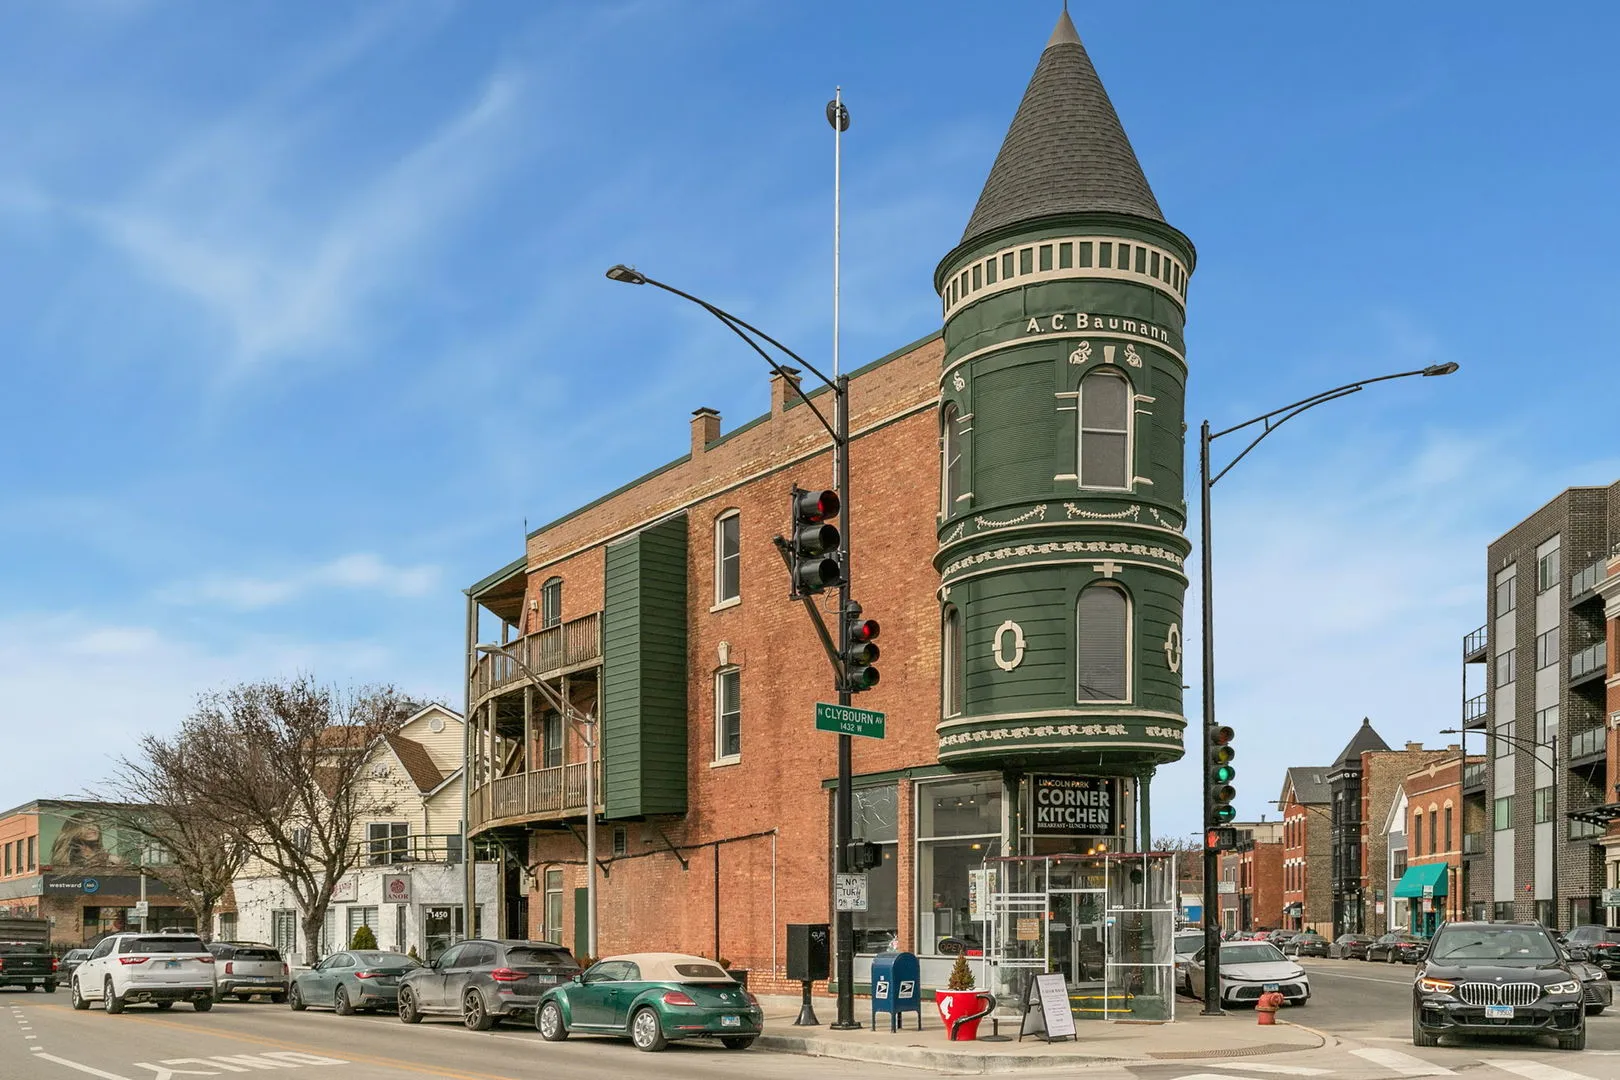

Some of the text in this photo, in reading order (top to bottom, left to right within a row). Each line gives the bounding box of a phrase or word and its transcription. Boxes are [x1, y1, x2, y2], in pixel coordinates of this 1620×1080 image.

[1026, 317, 1045, 333] A.
[1051, 314, 1068, 330] C.
[825, 707, 873, 724] CLYBOURN
[840, 722, 855, 732] 1432
[1038, 789, 1110, 806] CORNER
[1037, 807, 1109, 823] KITCHEN
[845, 878, 858, 886] NO
[431, 911, 448, 919] 1450
